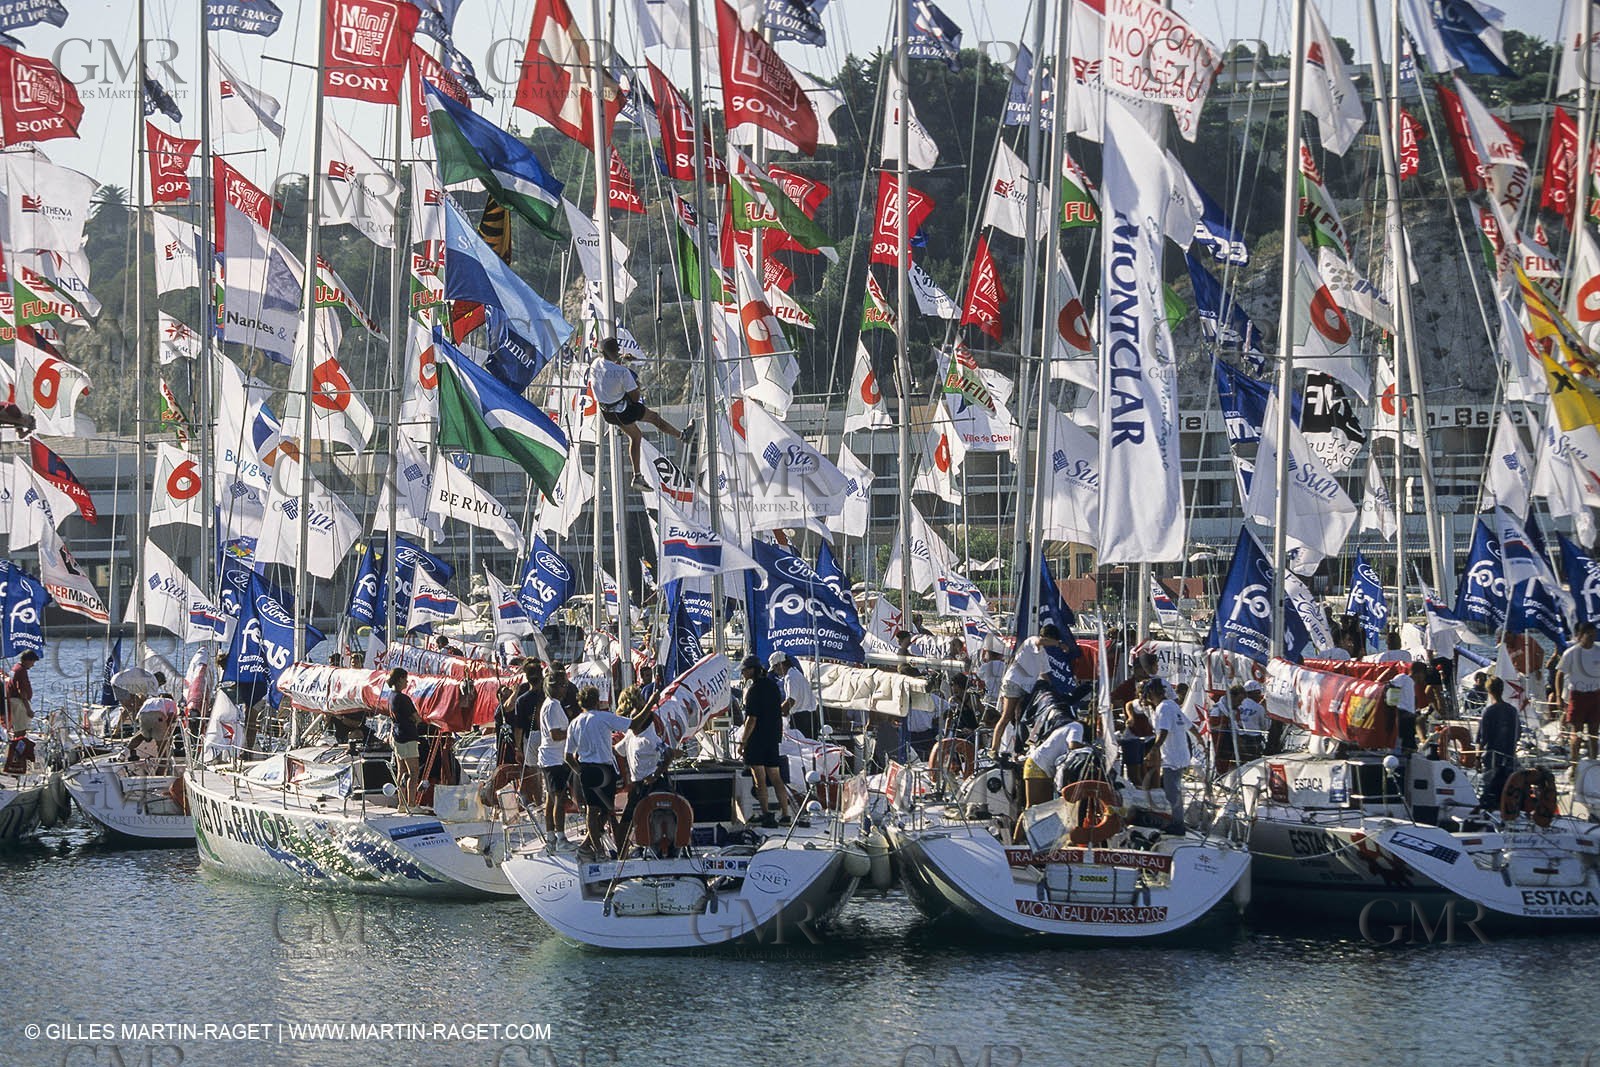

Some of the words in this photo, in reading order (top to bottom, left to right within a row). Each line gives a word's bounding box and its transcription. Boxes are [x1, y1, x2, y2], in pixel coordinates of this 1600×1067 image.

[329, 71, 389, 92] SONY
[731, 95, 798, 131] SONY
[16, 117, 65, 132] SONY
[42, 207, 72, 217] ATHENA
[227, 310, 275, 335] Nantes
[278, 327, 287, 341] &
[1295, 462, 1339, 498] Sun
[669, 526, 708, 543] Europe
[540, 554, 564, 575] Ford
[766, 582, 849, 629] focus
[767, 626, 815, 641] Lancement
[818, 628, 850, 642] Officiel
[784, 638, 819, 648] octobre
[822, 640, 844, 651] 1998
[1158, 650, 1206, 669] ATHENA
[1294, 777, 1323, 791] ESTACA
[1099, 853, 1166, 871] MORINEAU
[750, 871, 792, 887] ONET
[1079, 875, 1108, 883] ZODIAC
[1521, 890, 1599, 906] ESTACA
[1018, 900, 1087, 921] MORINEAU
